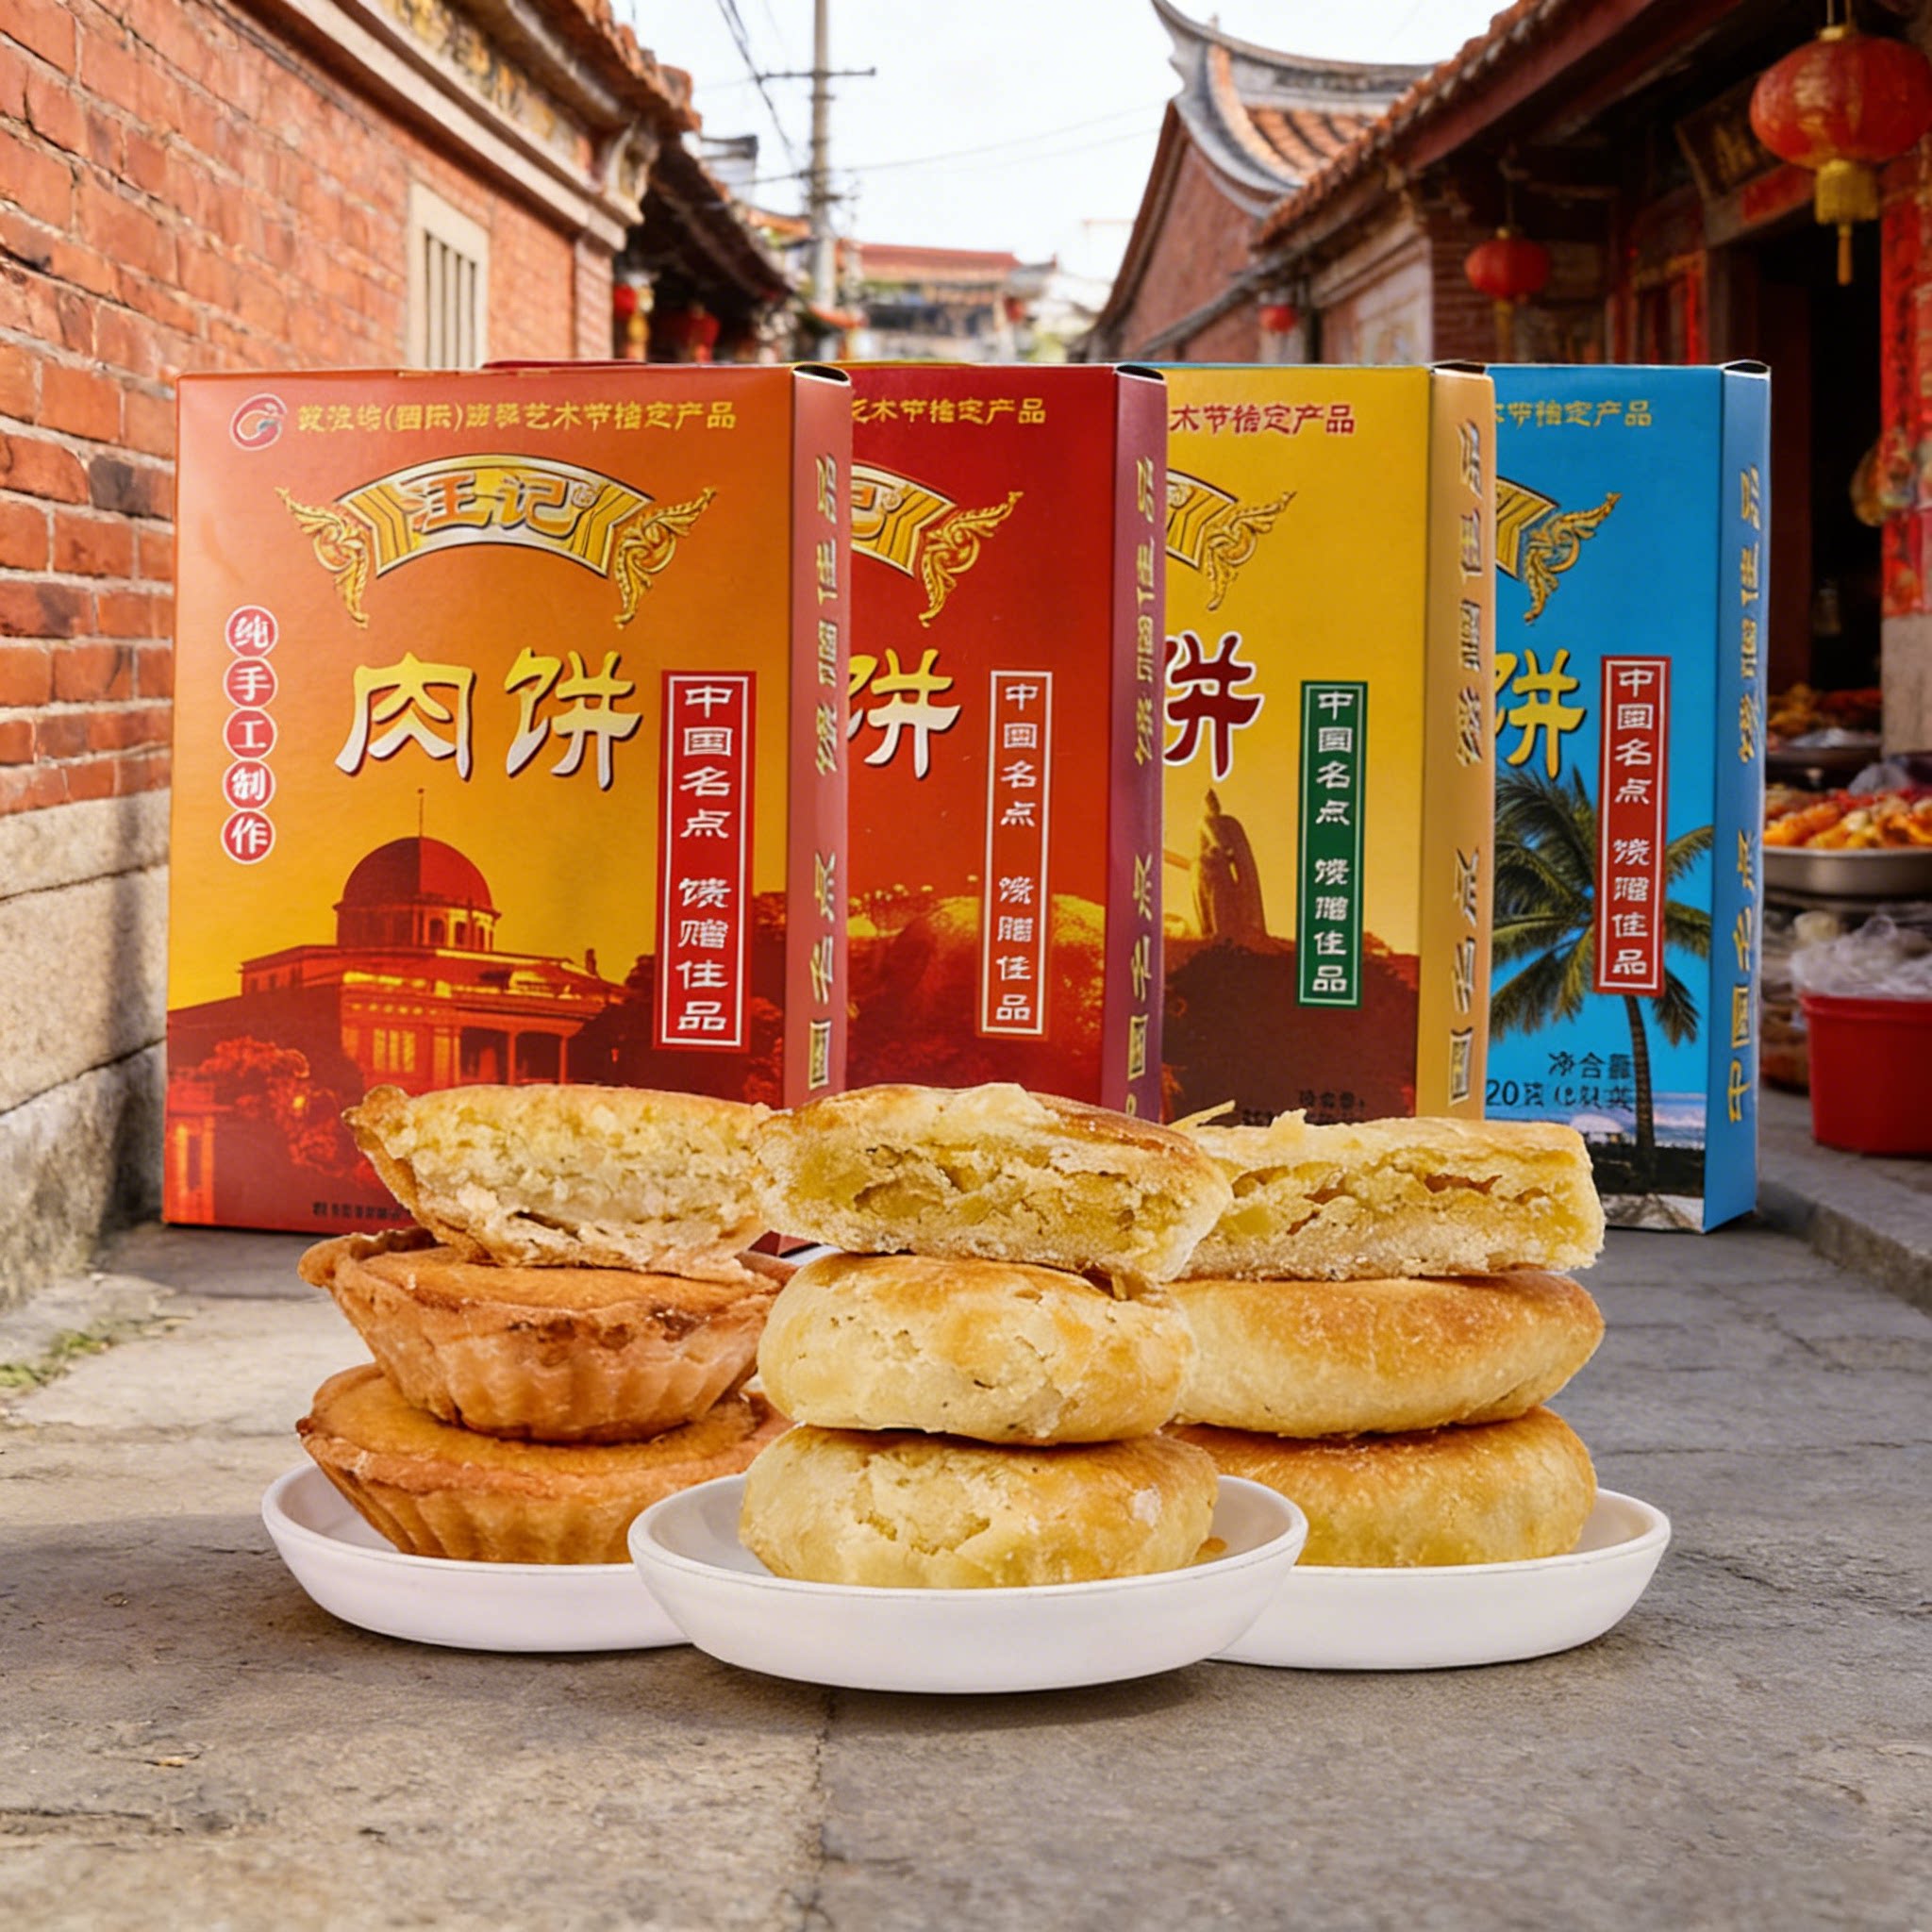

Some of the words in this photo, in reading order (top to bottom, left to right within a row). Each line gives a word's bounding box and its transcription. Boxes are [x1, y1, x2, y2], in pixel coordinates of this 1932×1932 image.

[231, 614, 272, 855] 纯手工制作
[334, 646, 645, 792] 肉饼
[679, 685, 734, 840] 中国名点
[1000, 682, 1039, 827] 中国名点
[1615, 668, 1654, 806] 中国名点
[1126, 853, 1153, 1119] 国名点
